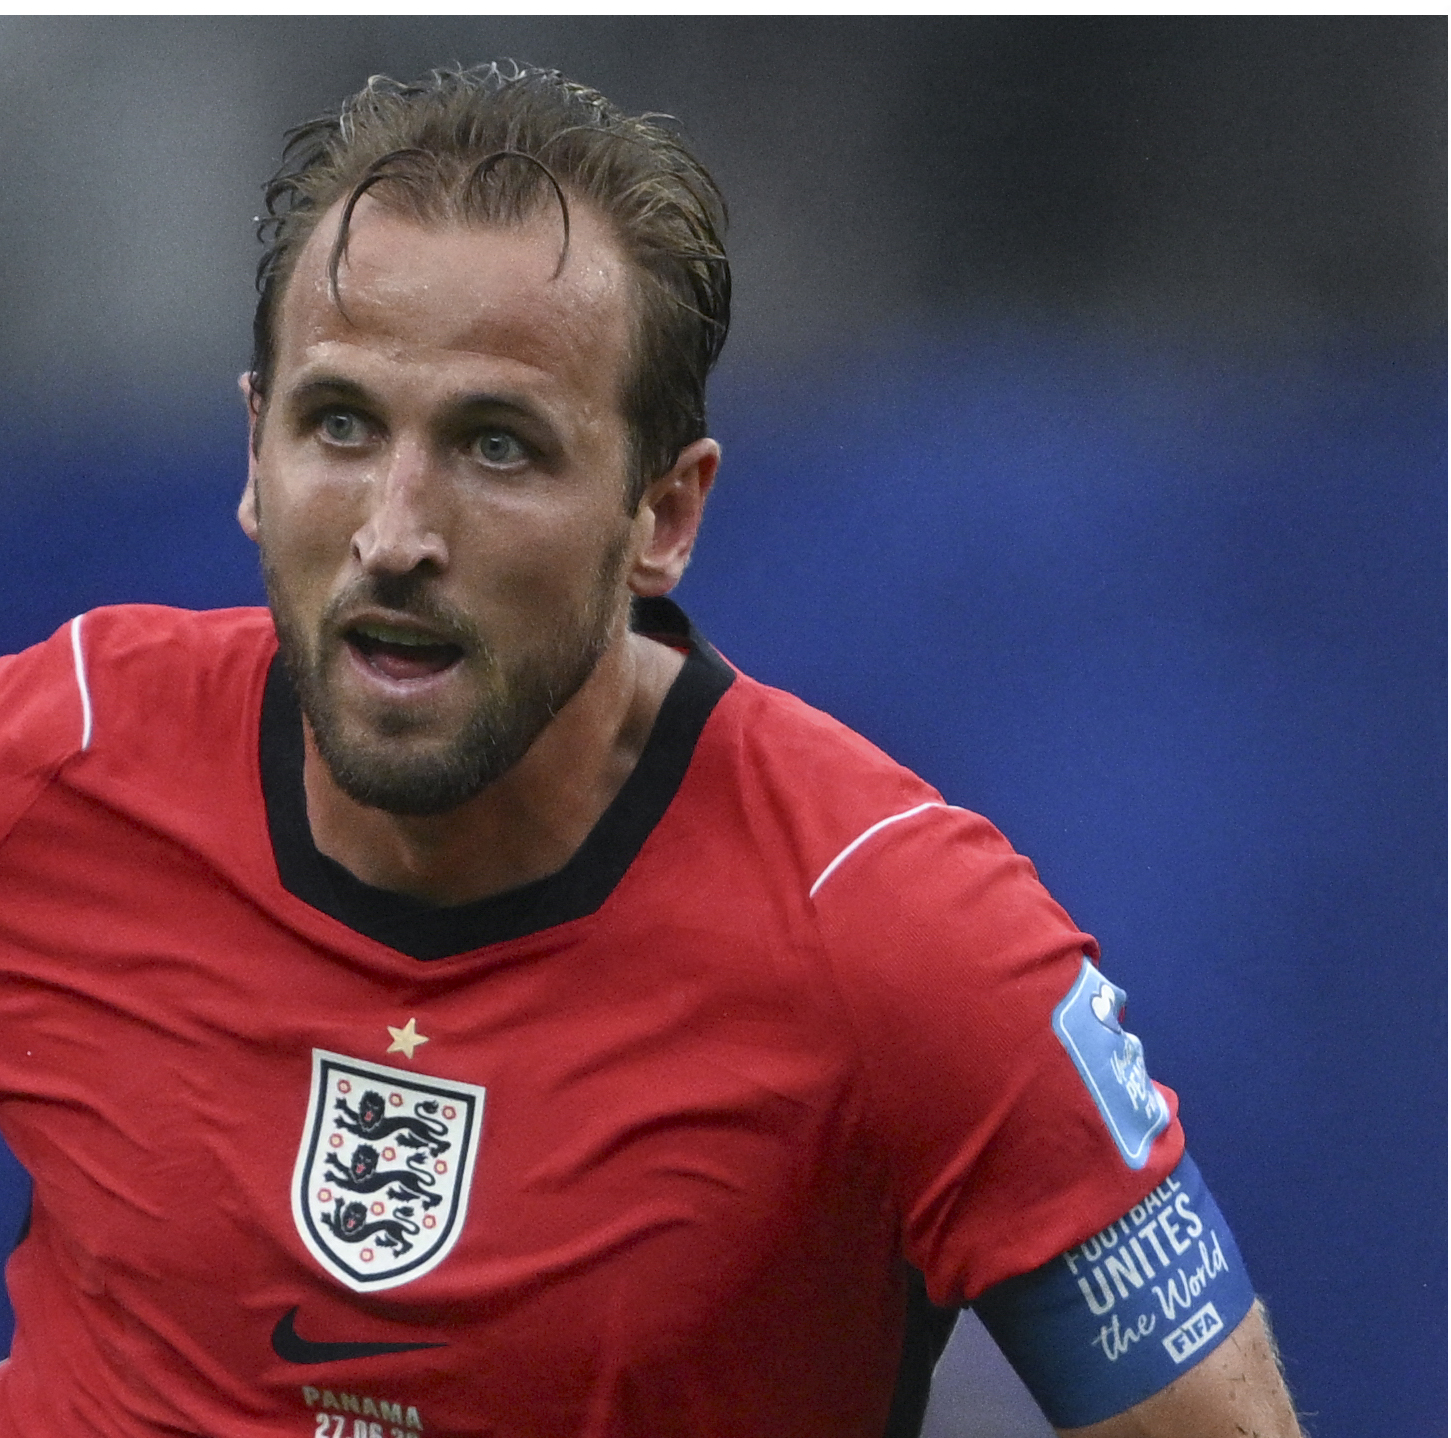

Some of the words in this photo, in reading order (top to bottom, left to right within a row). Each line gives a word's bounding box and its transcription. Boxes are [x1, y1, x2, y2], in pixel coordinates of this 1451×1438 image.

[1078, 1192, 1203, 1315] UNITES
[1091, 1314, 1155, 1361] the
[1152, 1229, 1229, 1320] World
[1169, 1311, 1220, 1356] FIFA
[302, 1385, 423, 1431] PANAMA
